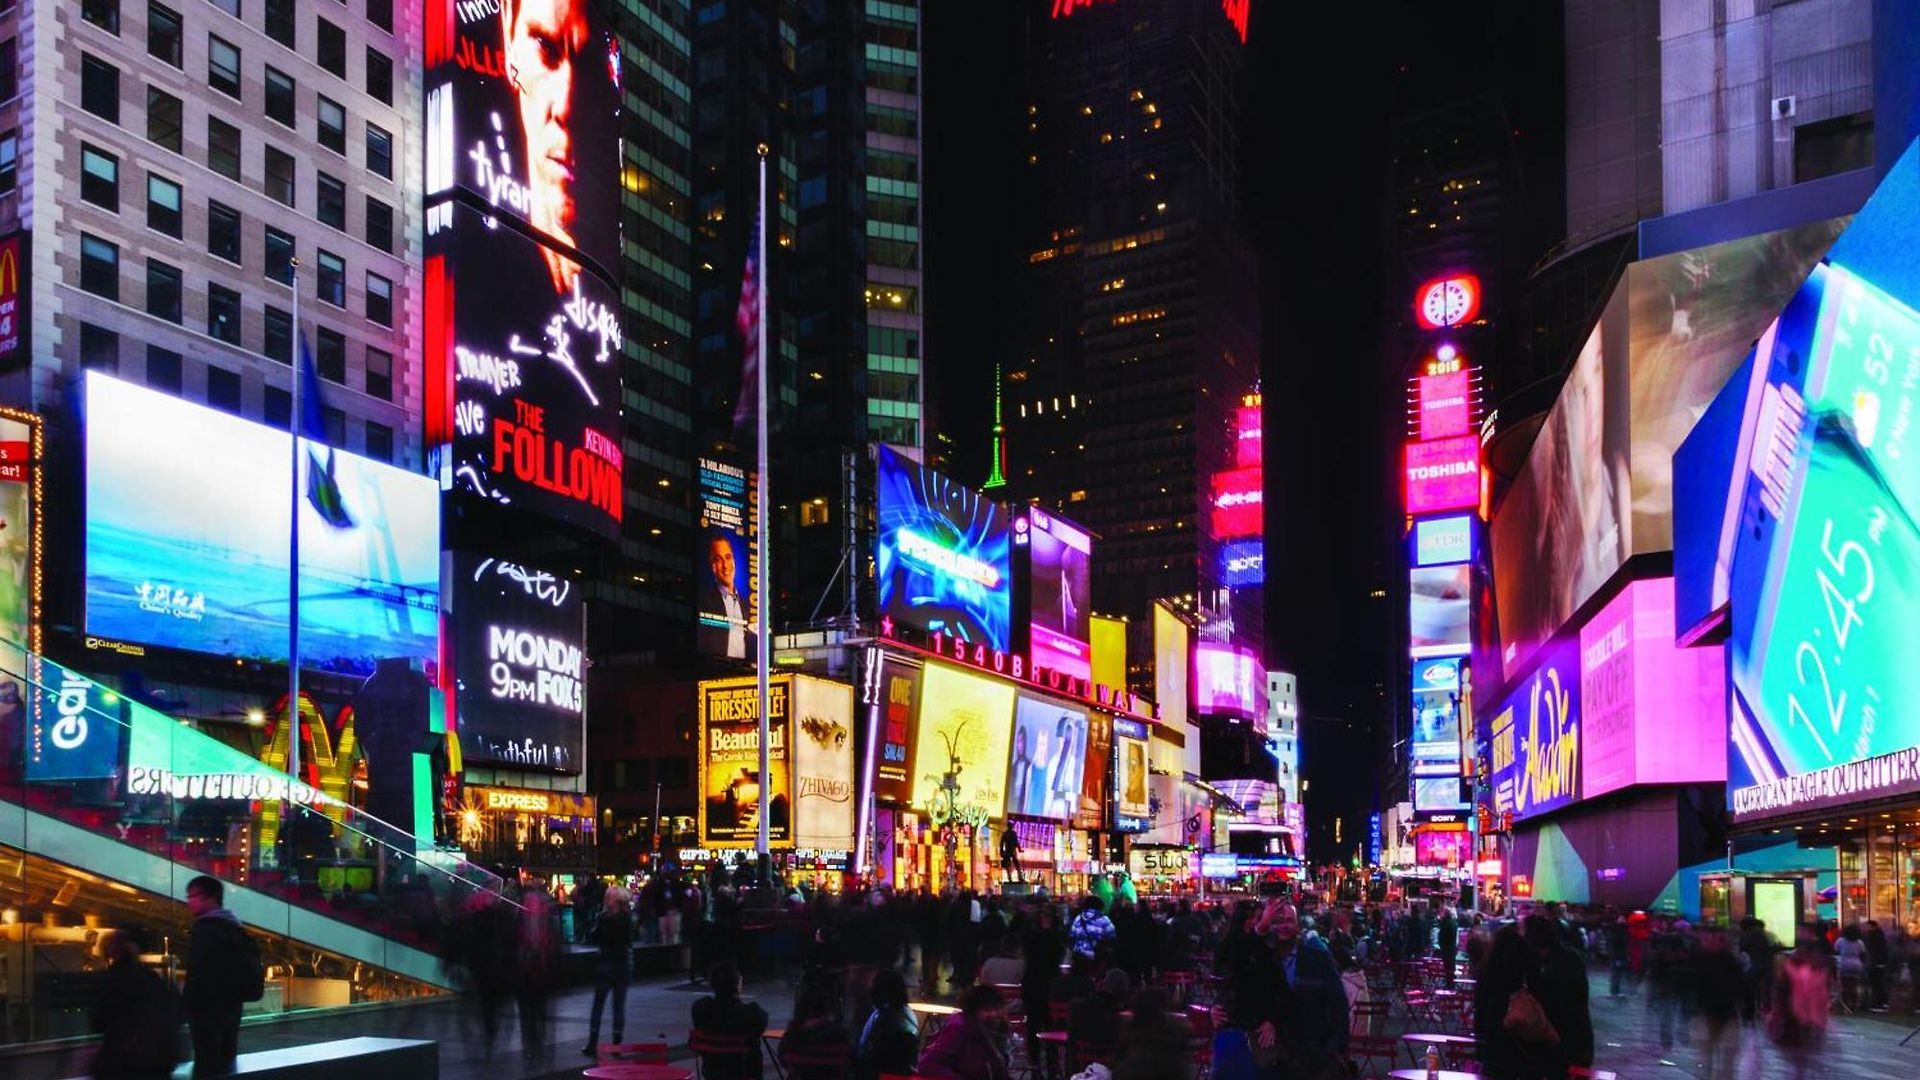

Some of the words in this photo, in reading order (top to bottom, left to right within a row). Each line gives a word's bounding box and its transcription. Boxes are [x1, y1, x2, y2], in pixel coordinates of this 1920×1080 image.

[515, 399, 545, 432] THE
[1424, 397, 1465, 410] TOSHIBA
[0, 465, 20, 477] ar!
[1407, 460, 1477, 482] TOSHIBA
[490, 625, 582, 679] MONDAY
[1787, 517, 1875, 763] 12:45
[711, 724, 784, 751] Beautiul
[1514, 667, 1578, 812] Aladdin
[800, 776, 851, 801] ZHIVAGO
[1732, 776, 1788, 815] AMERICAN
[1790, 769, 1829, 802] EAGLE
[488, 792, 549, 813] EXPRESS
[1430, 814, 1456, 823] SONY
[679, 849, 711, 861] GIFTS
